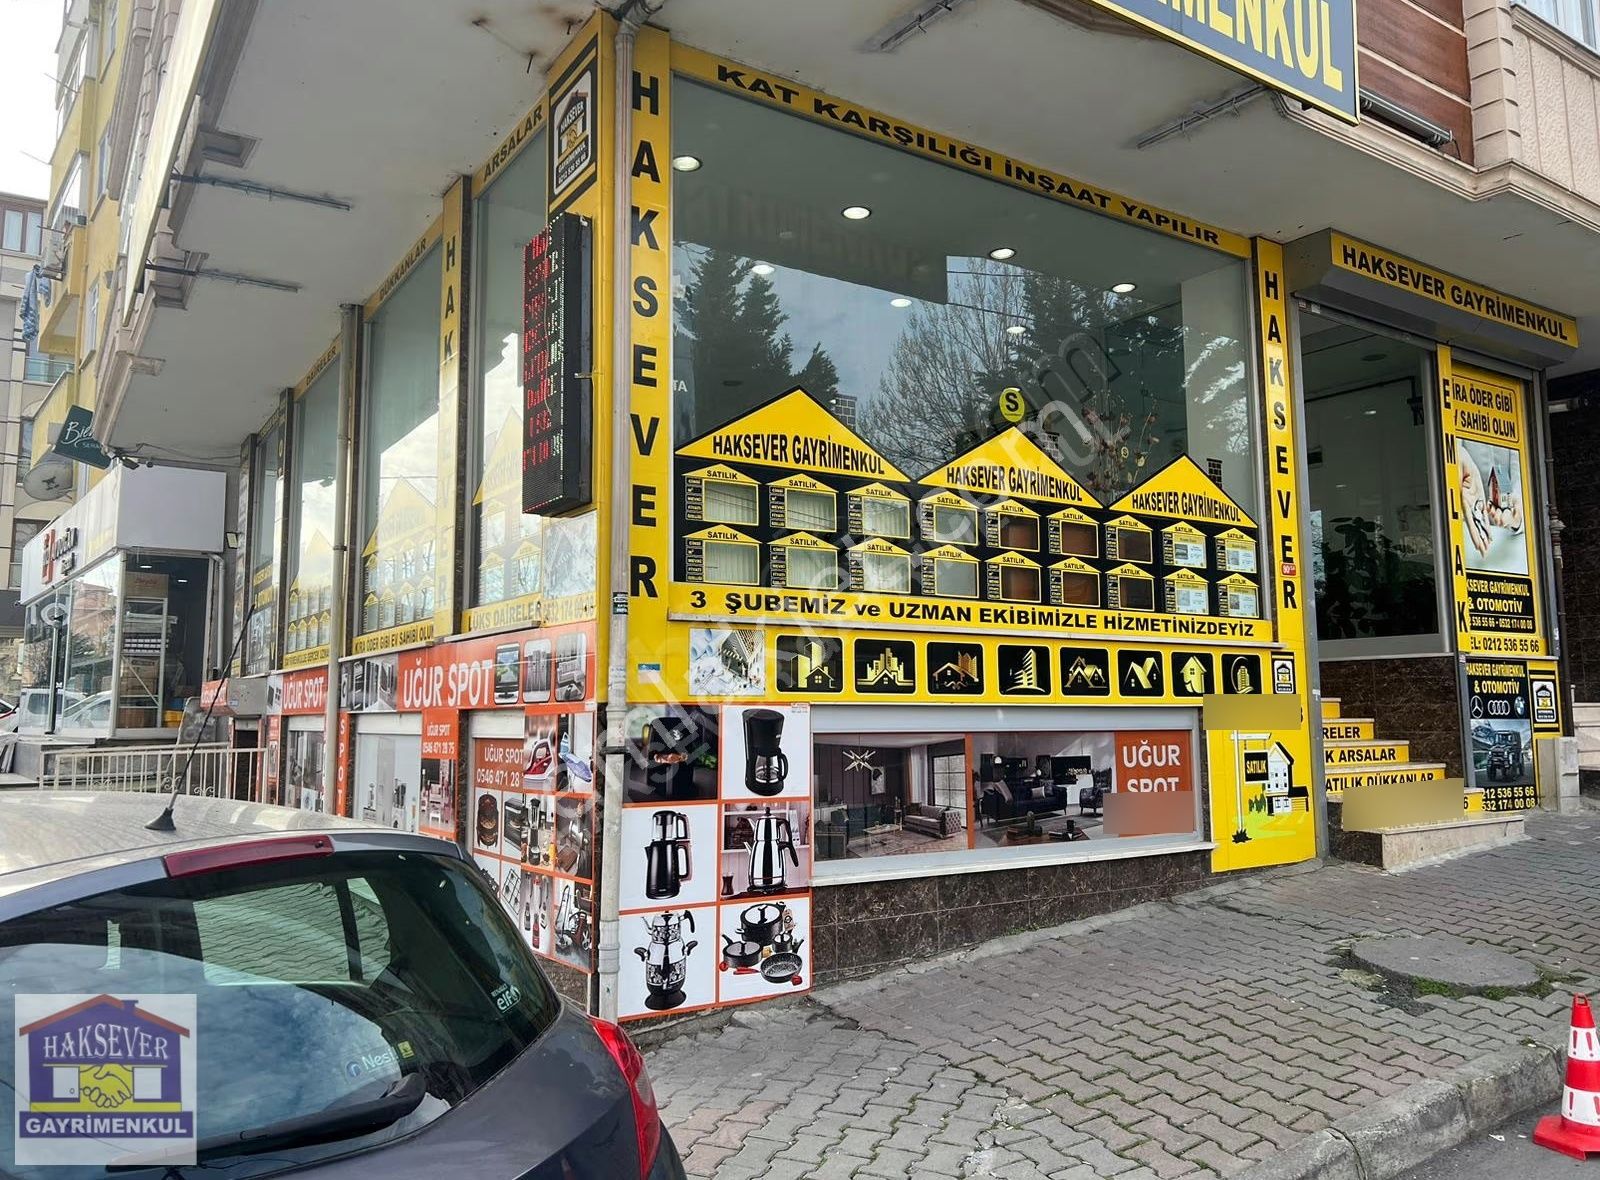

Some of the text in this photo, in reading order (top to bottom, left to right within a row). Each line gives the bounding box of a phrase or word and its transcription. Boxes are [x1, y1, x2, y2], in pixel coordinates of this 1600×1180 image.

[483, 104, 543, 182] ARSALAR
[718, 64, 1219, 245] KAT KARŞILIĞI İNŞAAT YAPILIR
[1342, 244, 1567, 340] HAKSEVER GAYRİMENKUL
[630, 70, 661, 598] HAKSEVER
[1470, 384, 1494, 409] ÖDER
[1495, 391, 1513, 413] GİBİ
[1461, 409, 1491, 433] SAHİBİ
[1493, 417, 1516, 438] OLUN
[1264, 271, 1297, 609] HAKSEVER
[713, 434, 885, 475] HAKSEVER GAYRİMENKUL
[707, 470, 738, 479] SATILIK
[788, 480, 817, 488] SATILIK
[947, 466, 1082, 502] HAKSEVER GAYRİMENKUL
[865, 488, 892, 497] SATILIK
[937, 497, 961, 505] SATILIK
[1001, 504, 1024, 513] SATILIK
[1132, 490, 1241, 522] HAKSEVER GAYRİMENKUL
[1062, 512, 1084, 521] SATILIK
[1119, 519, 1139, 528] SATILIK
[707, 531, 739, 540] SATILIK
[789, 538, 818, 546] SATILIK
[866, 544, 893, 552] SATILIK
[937, 550, 962, 558] SATILIK
[1002, 556, 1025, 564] SATILIK
[1063, 562, 1085, 570] SATILIK
[1120, 567, 1140, 576] SATILIK
[1477, 598, 1522, 613] OTOMOTİV
[690, 590, 1254, 637] 3 ŞUBEMİZ ve UZMAN EKİBİMİZLE HİZMETİNİZDEYİZ
[1483, 637, 1501, 651] 0212
[1504, 638, 1517, 651] 536
[1520, 639, 1528, 652] 55
[1530, 639, 1539, 652] 66
[403, 658, 493, 708] UĞUR SPOT
[1474, 679, 1520, 694] & OTOMOTİV
[283, 675, 324, 709] UĞUR SPOT
[484, 744, 524, 765] UĞUR SPOT
[1123, 739, 1181, 768] UĞUR
[1326, 748, 1396, 763] K ARSALAR
[1246, 760, 1267, 774] SATILIK
[477, 768, 520, 787] 0546 471 28
[1497, 788, 1512, 798] 536
[1513, 787, 1524, 797] 55
[1525, 786, 1535, 796] 66
[1498, 799, 1513, 810] 174
[1514, 799, 1524, 809] 00
[1525, 798, 1536, 808] 08
